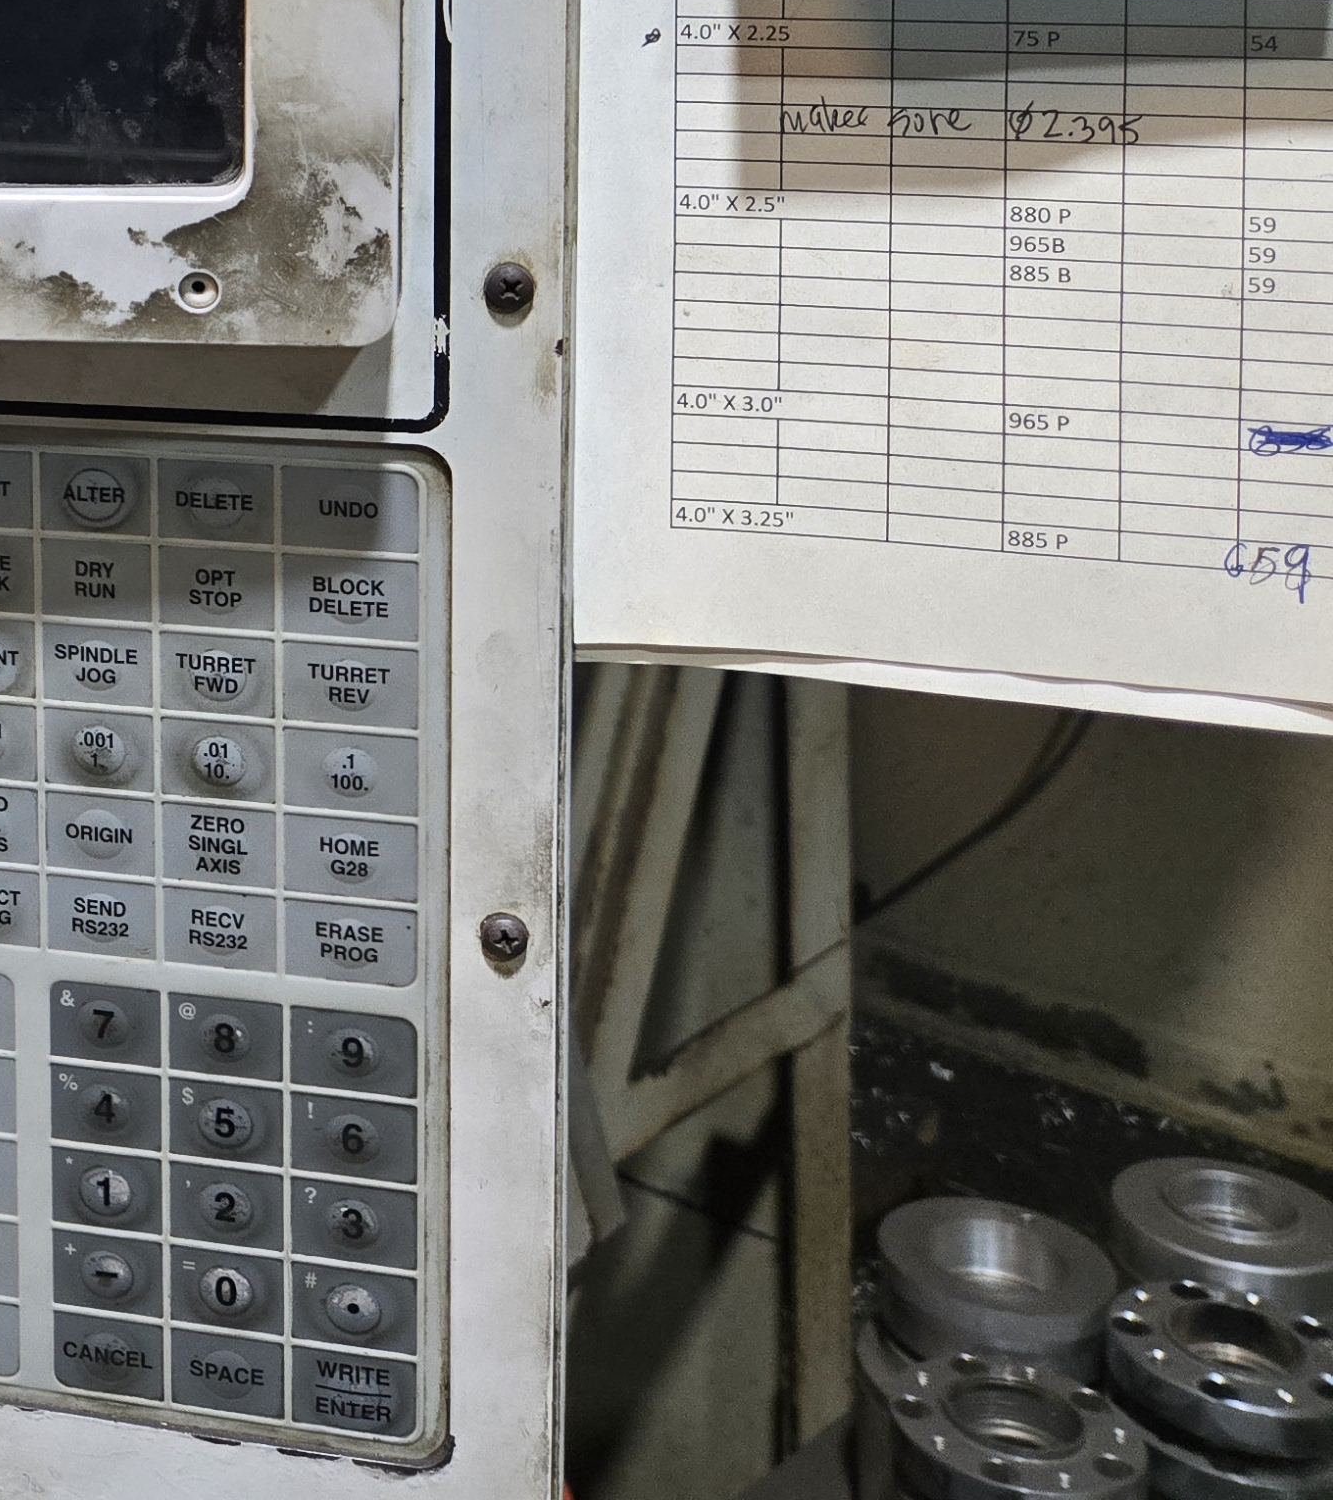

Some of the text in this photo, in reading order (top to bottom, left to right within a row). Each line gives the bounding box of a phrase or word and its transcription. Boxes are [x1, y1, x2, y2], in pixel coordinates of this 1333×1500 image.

[680, 23, 790, 41] 4.0" X 2.25
[1013, 30, 1060, 46] 75 P
[1251, 35, 1278, 52] 54
[679, 194, 785, 212] 4.0" X 2.5"
[1009, 206, 1072, 224] 880 P
[1248, 217, 1277, 233] 59
[1009, 236, 1065, 253] 965B
[1248, 247, 1276, 264] 59
[1009, 265, 1071, 283] 885 B
[1248, 277, 1276, 293] 59
[676, 393, 782, 412] 4.0" X 3.0"
[1009, 412, 1070, 431] 965 P
[175, 490, 253, 511] DELETE
[319, 500, 379, 519] UNDO
[675, 507, 794, 528] 4.0" X 3.25"
[1007, 530, 1068, 549] 885 P
[65, 822, 133, 844] ORIGIN
[63, 1342, 153, 1370] CANCEL
[190, 1360, 264, 1386] SPACE
